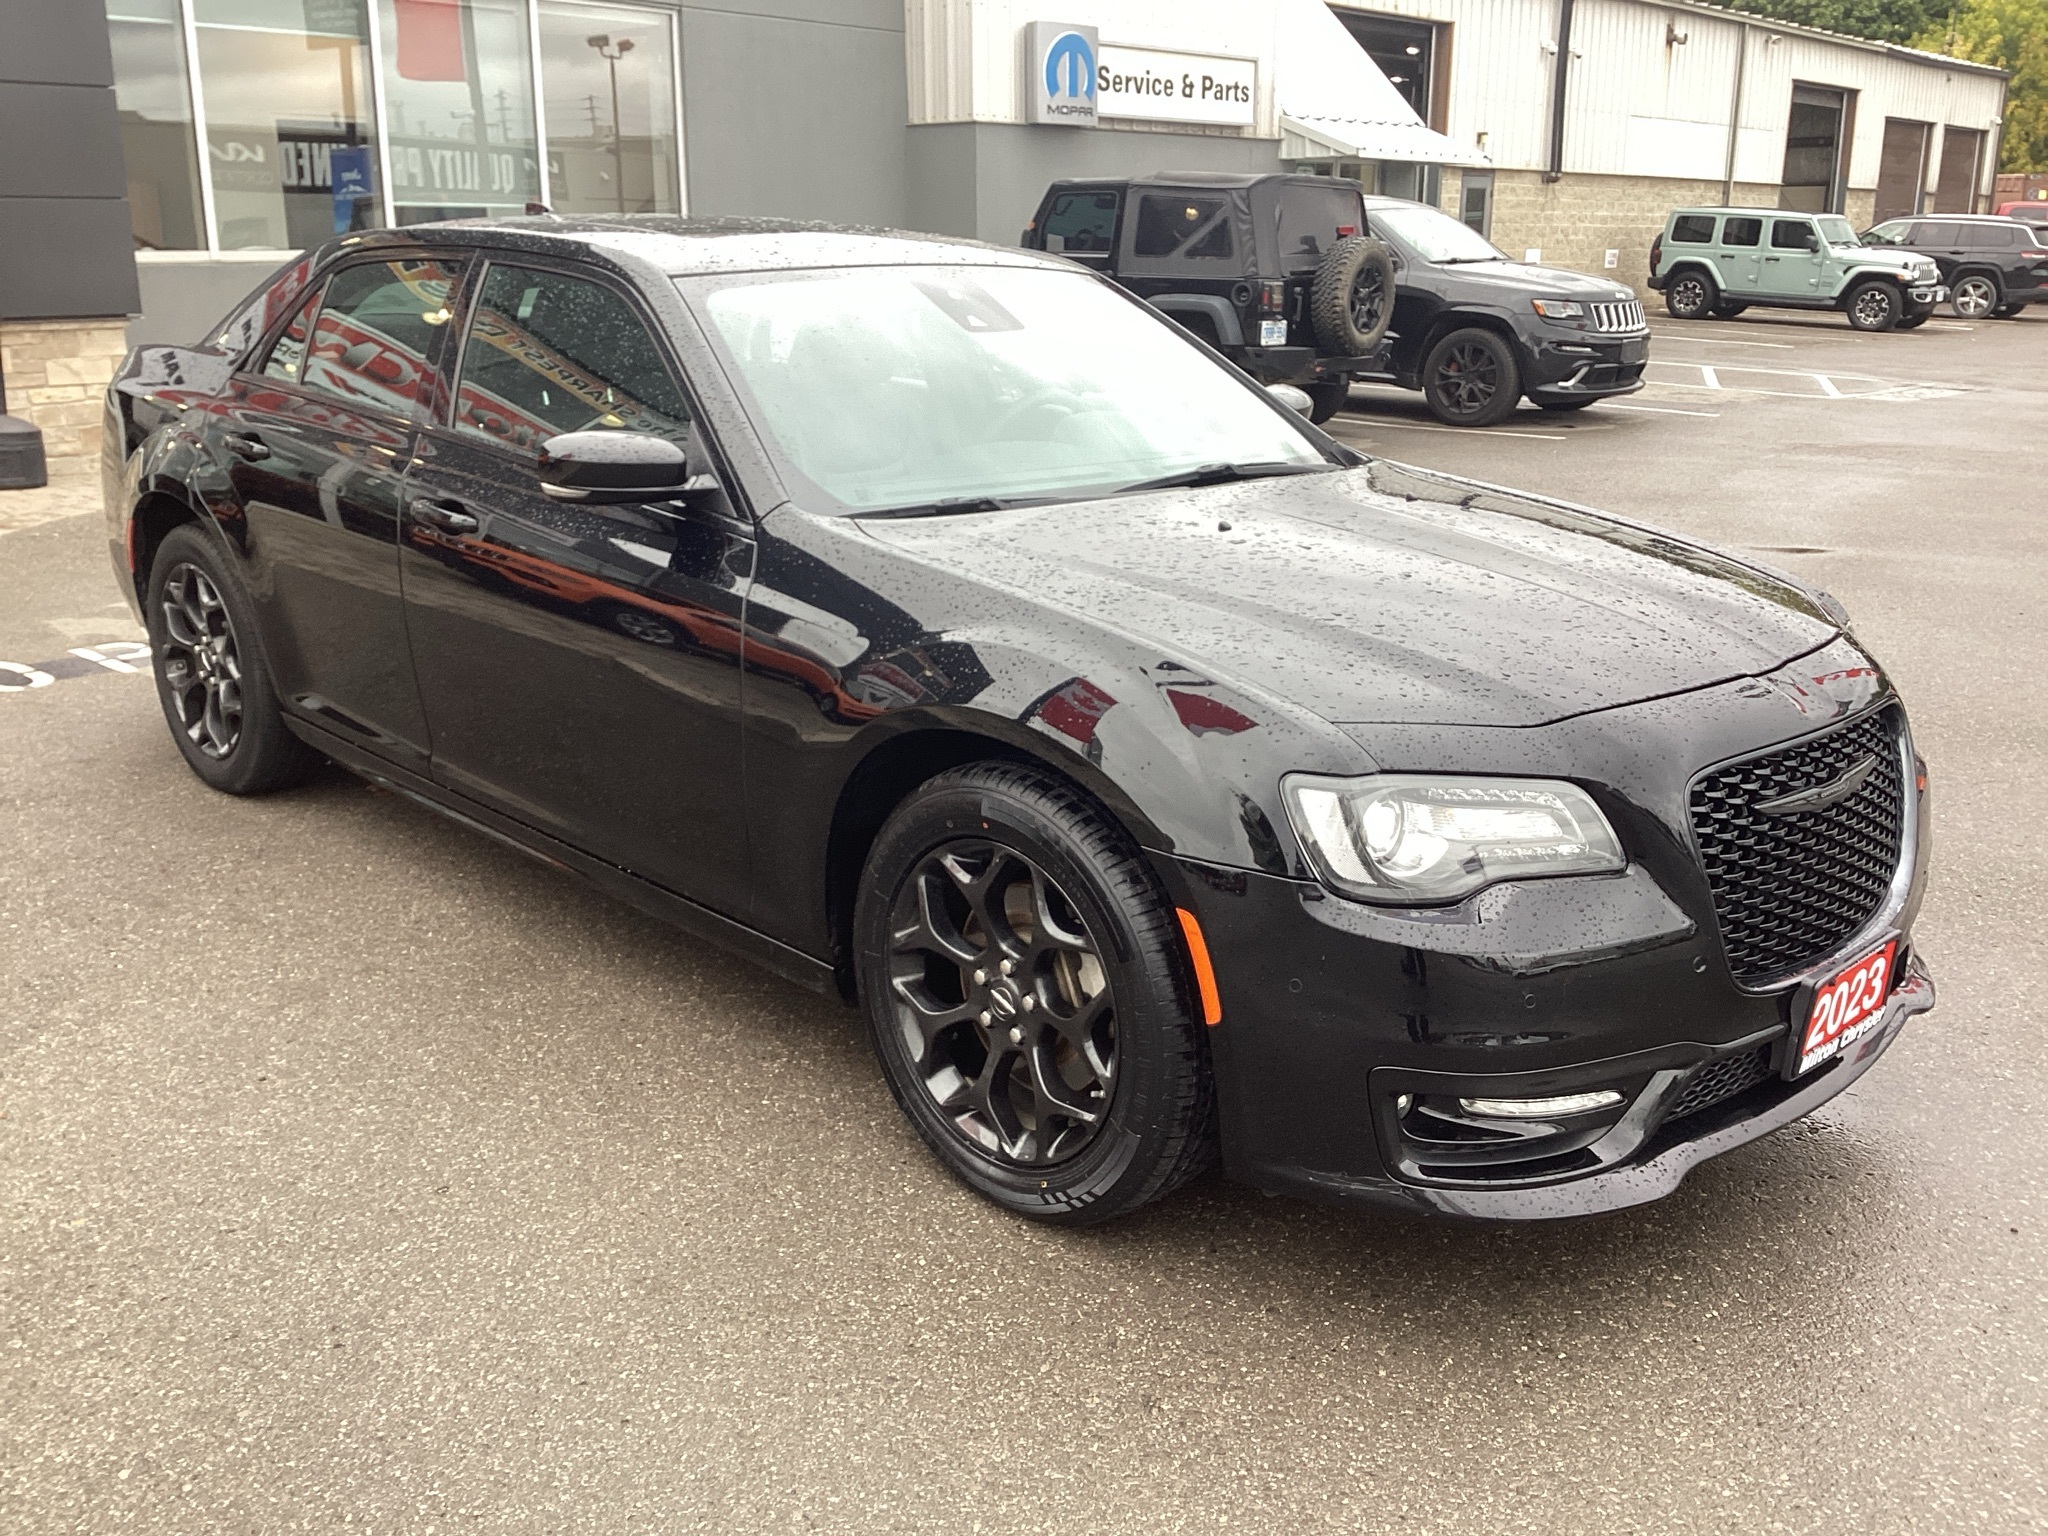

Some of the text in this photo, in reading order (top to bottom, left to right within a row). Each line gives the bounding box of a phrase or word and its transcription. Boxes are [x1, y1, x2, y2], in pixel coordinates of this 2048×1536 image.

[1097, 65, 1250, 102] Service & Parts
[1047, 104, 1094, 117] MOPAR
[1806, 957, 1886, 1051] 2023
[1799, 1005, 1886, 1074] Milton Chrysler
